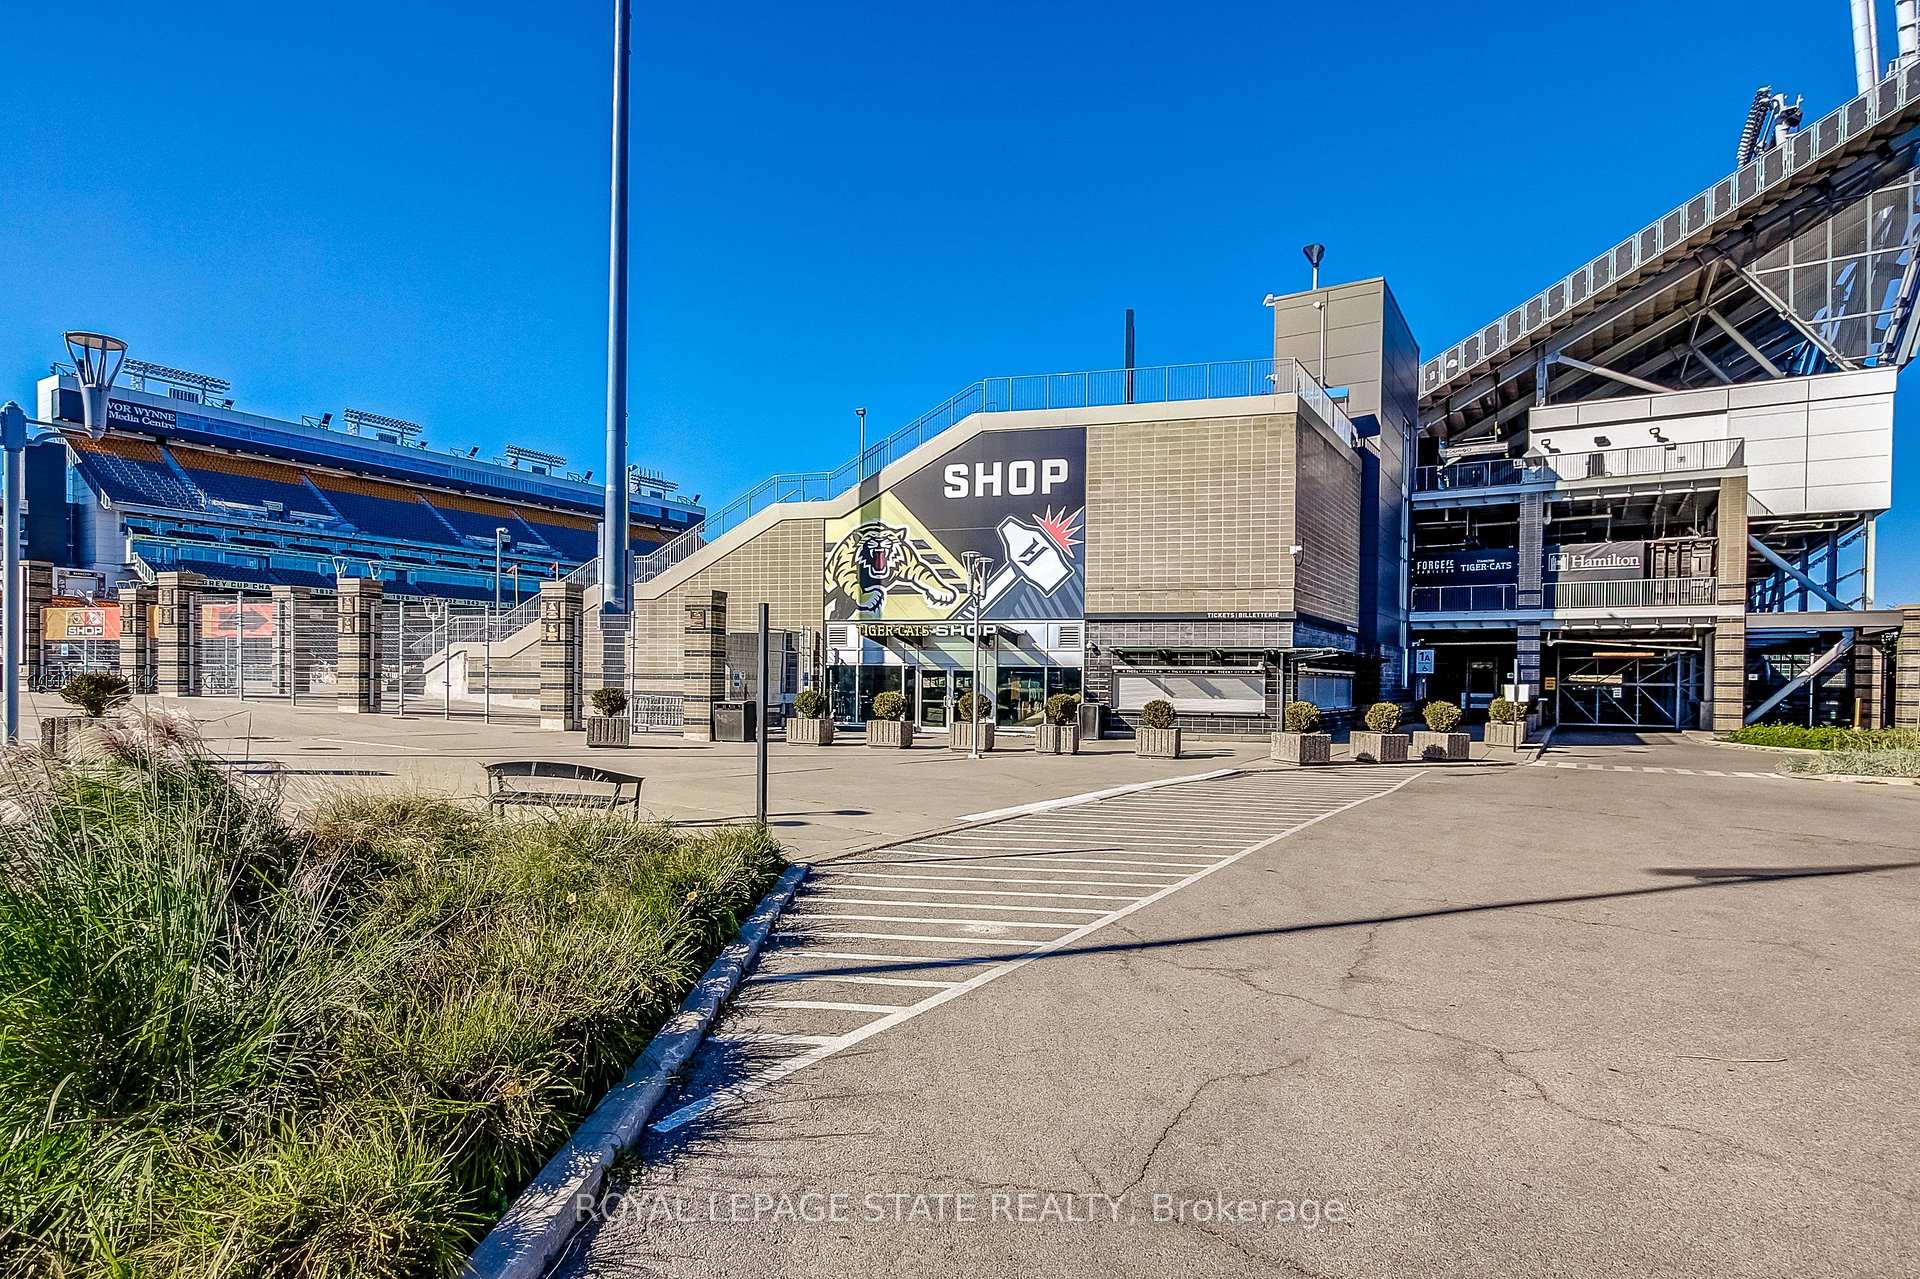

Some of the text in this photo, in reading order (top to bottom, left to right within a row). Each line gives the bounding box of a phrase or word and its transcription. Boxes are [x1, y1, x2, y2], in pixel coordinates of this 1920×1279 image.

[106, 402, 176, 421] VOR WYNNE
[108, 410, 176, 429] Media Centre
[943, 458, 1069, 499] SHOP
[1416, 560, 1447, 570] FORGE
[1460, 561, 1512, 572] TIGER-CATS
[1570, 553, 1640, 568] Hamilton
[230, 581, 249, 589] CUP
[67, 626, 104, 635] SHOP
[857, 623, 997, 637] TIGER-CATS SHOP
